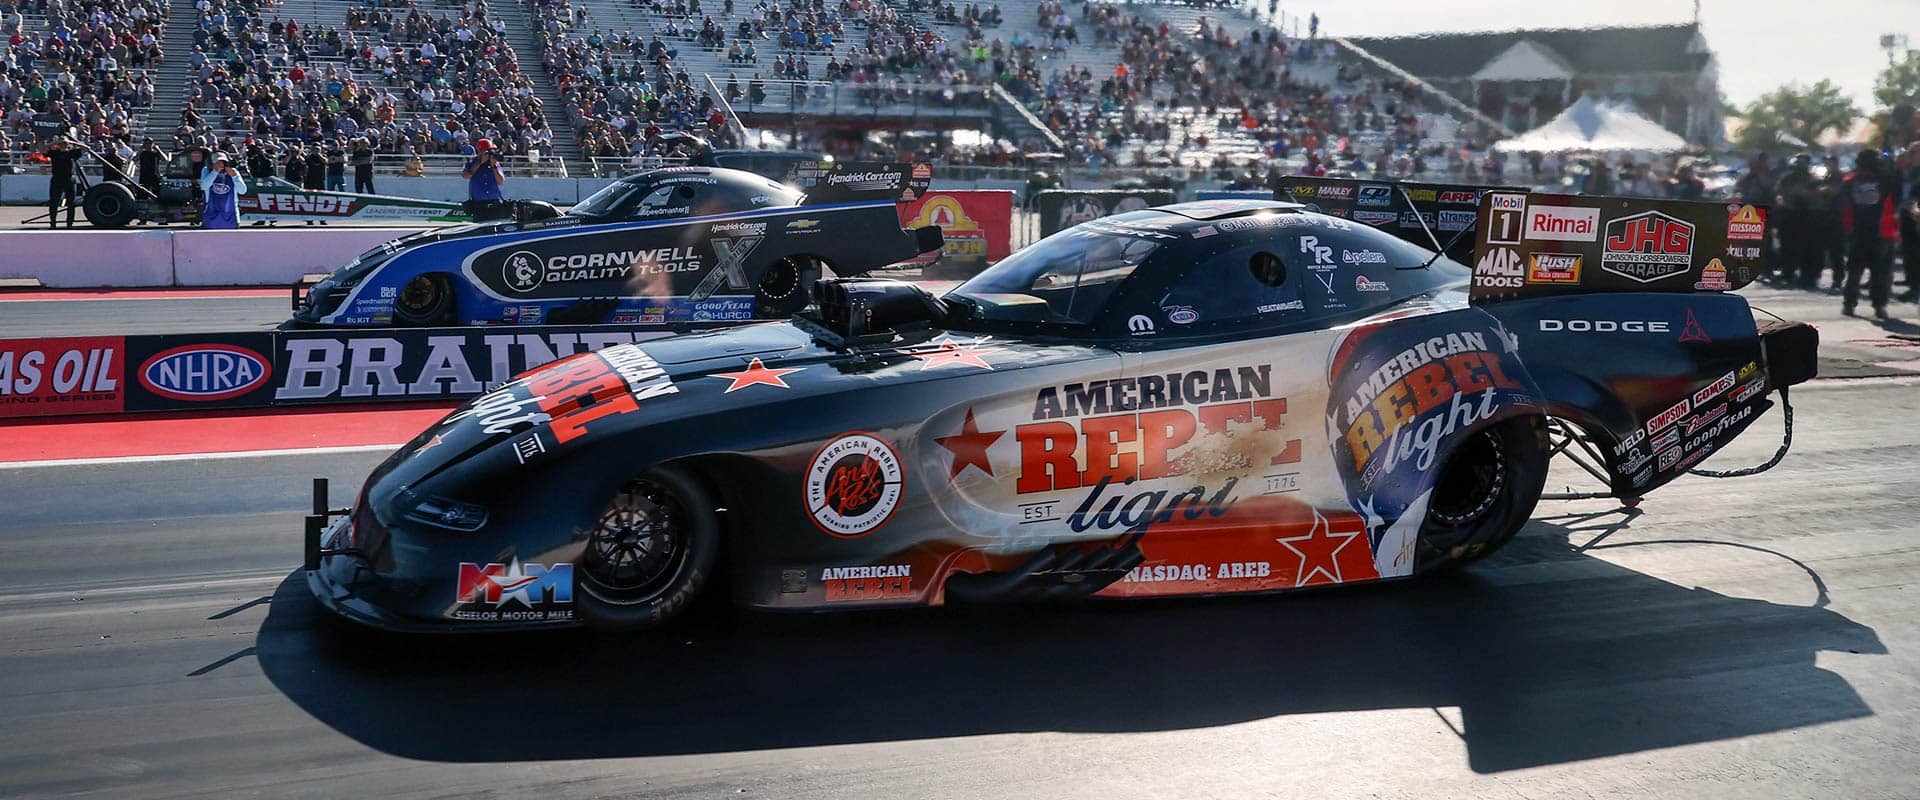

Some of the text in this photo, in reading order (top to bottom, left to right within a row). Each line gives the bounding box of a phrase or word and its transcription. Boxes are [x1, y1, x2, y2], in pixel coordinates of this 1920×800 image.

[827, 171, 902, 187] HendrickCars.com
[1318, 185, 1353, 196] MANLEY
[257, 192, 358, 215] FENDT
[1440, 191, 1475, 204] ARP
[1492, 195, 1523, 209] Mobil
[1500, 211, 1510, 240] 1
[1533, 212, 1593, 234] Rinnai
[1608, 217, 1692, 254] JHG
[546, 260, 701, 282] QUALITY TOOLS
[548, 246, 698, 271] CORNWELL
[1475, 247, 1524, 276] MAC
[1604, 254, 1690, 264] JOHNSON'S HORSEPOWERED
[1616, 262, 1675, 278] GARAGE
[1475, 276, 1524, 288] TOOLS
[711, 311, 752, 321] HURCO
[1539, 318, 1670, 334] DODGE
[52, 348, 117, 394] OIL
[160, 354, 254, 392] NHRA
[274, 330, 683, 405] BRAIN
[1346, 331, 1488, 427] AMERICAN
[46, 393, 117, 404] SERIES
[1033, 364, 1272, 421] AMERICAN
[1345, 352, 1524, 473] REBEL
[1649, 401, 1688, 433] SIMPSON
[1382, 386, 1500, 475] light
[1613, 427, 1646, 457] WELD
[812, 440, 897, 502] THE AMERICAN REBEL
[854, 508, 887, 529] PATRIOTIC
[887, 489, 896, 506] FUEL
[1024, 475, 1297, 540] EST light 1776
[821, 564, 912, 581] AMERICAN
[1122, 560, 1271, 583] NASDAQ: AREB
[825, 576, 917, 602] REBEL
[455, 609, 574, 620] SHELOR MOTOR MILE
